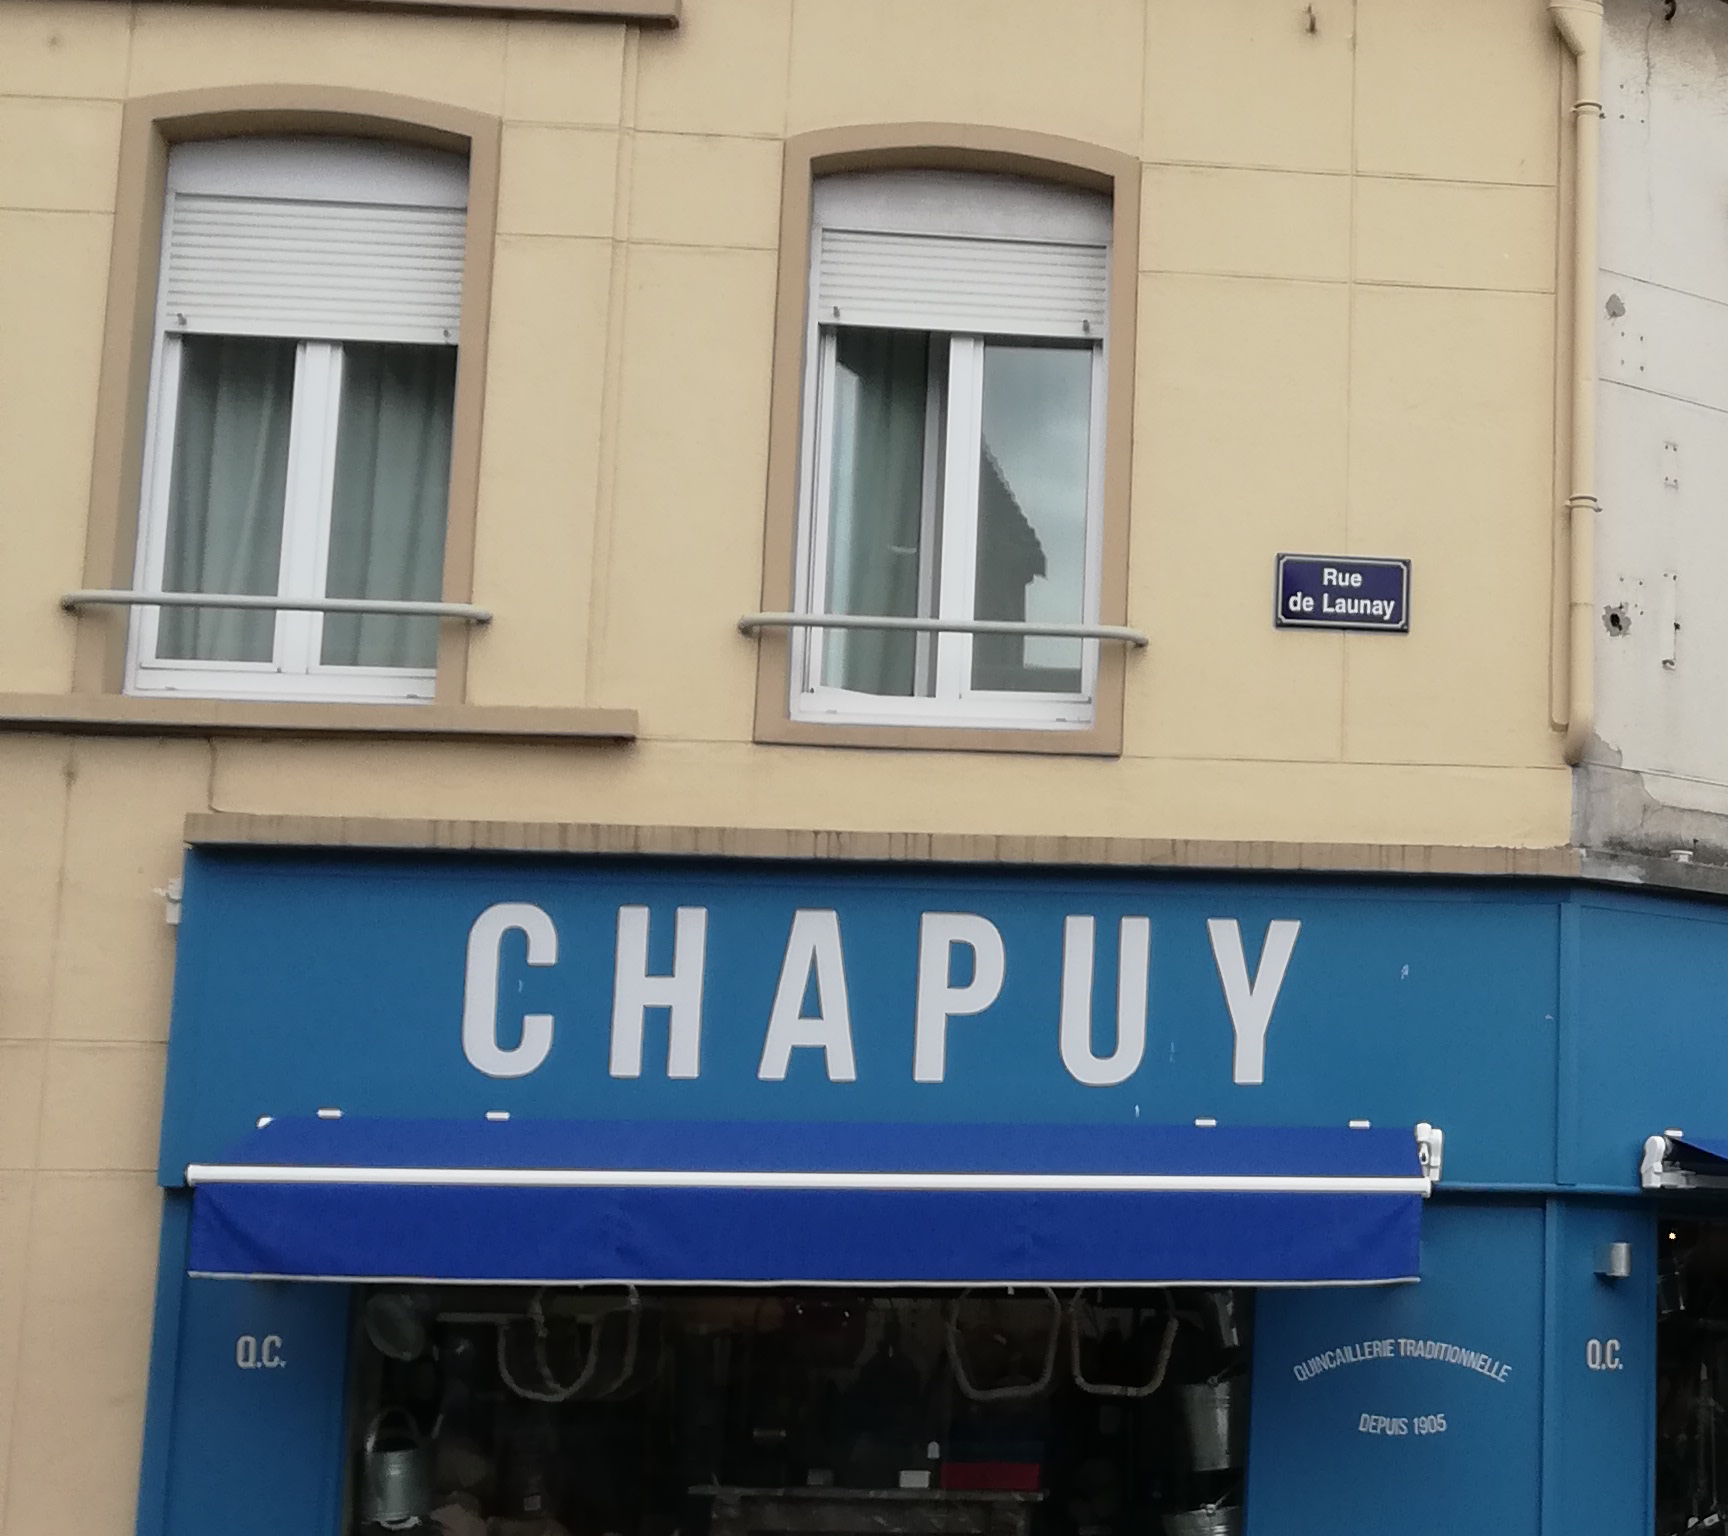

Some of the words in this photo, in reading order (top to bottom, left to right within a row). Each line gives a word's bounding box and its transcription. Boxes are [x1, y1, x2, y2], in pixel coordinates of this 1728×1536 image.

[1323, 568, 1362, 587] Rue
[1288, 592, 1314, 612] de
[1323, 593, 1395, 620] Launay
[462, 902, 1302, 1086] CHAPUY
[236, 1335, 287, 1370] Q.C.
[1293, 1339, 1395, 1382] QUINCAILLERIE
[1397, 1338, 1513, 1383] TRADITIONNELLE
[1586, 1338, 1624, 1370] Q.C.
[1358, 1413, 1409, 1436] DEPUIS
[1413, 1413, 1447, 1436] 1905
